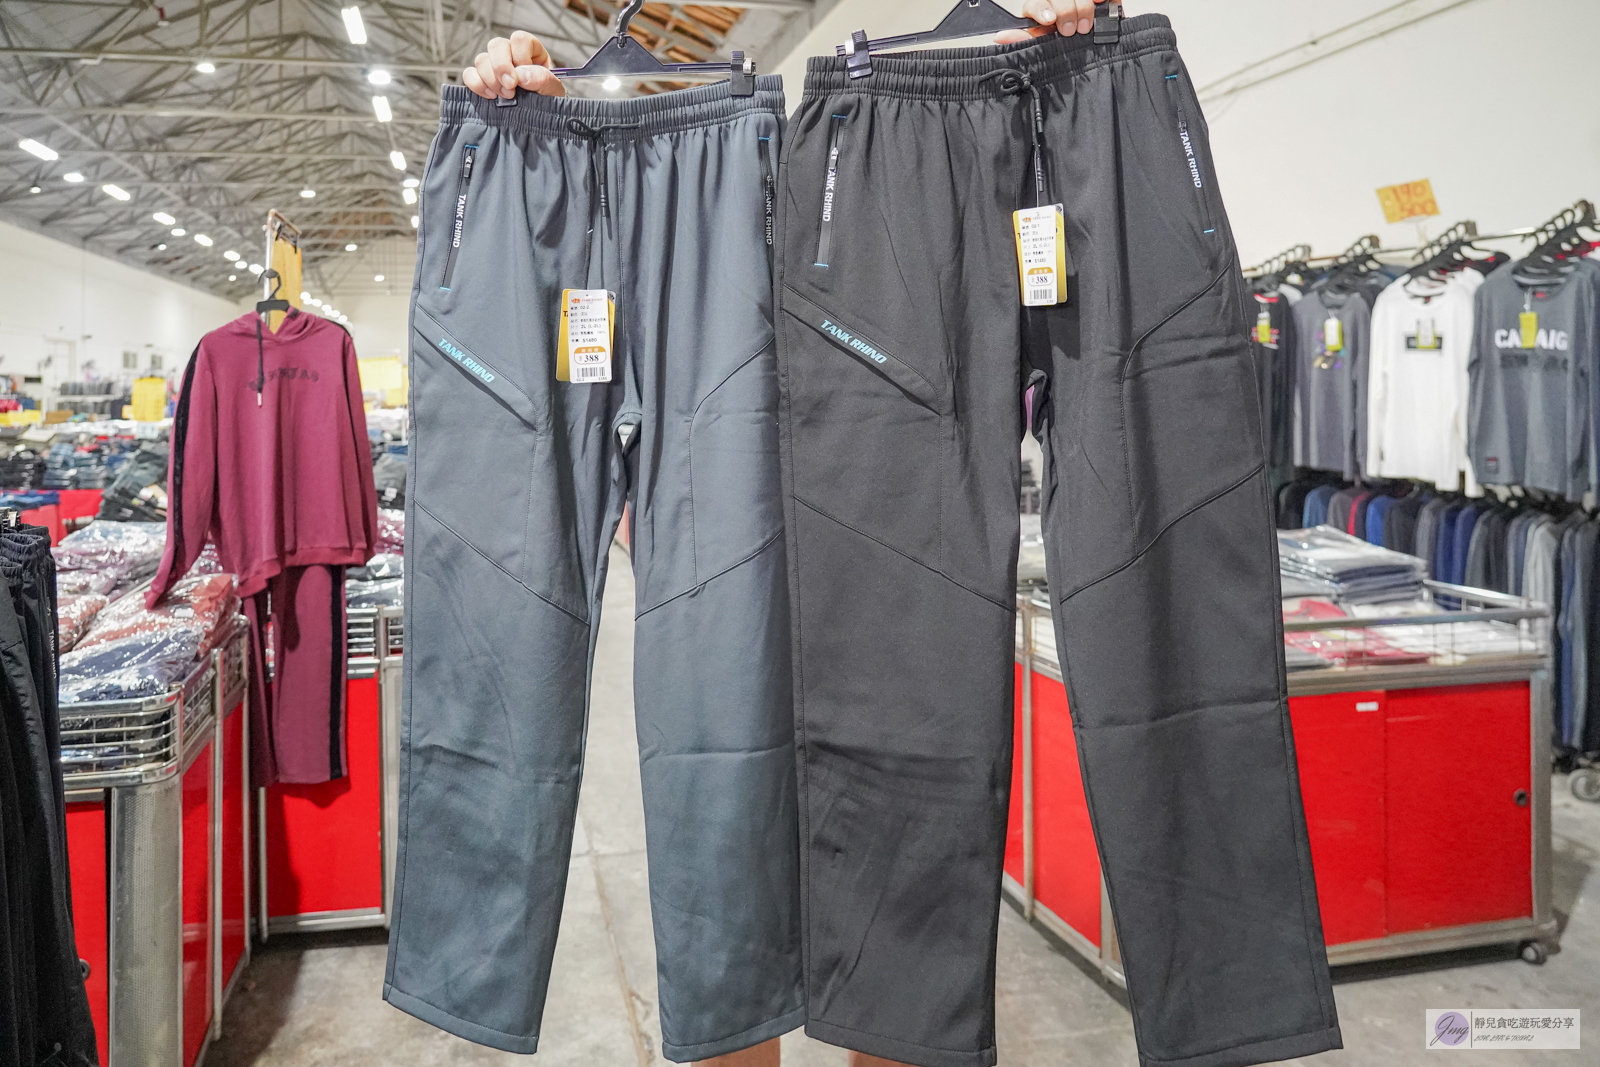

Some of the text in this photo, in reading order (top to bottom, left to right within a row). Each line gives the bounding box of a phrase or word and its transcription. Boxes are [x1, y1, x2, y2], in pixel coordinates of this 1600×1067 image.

[1179, 130, 1194, 156] TANK
[455, 194, 467, 218] TANK
[1035, 275, 1048, 284] 388
[820, 319, 888, 364] TANK RHINO
[1494, 328, 1568, 351] CAAIG
[437, 338, 496, 383] TANK RHINO
[584, 354, 599, 363] 388
